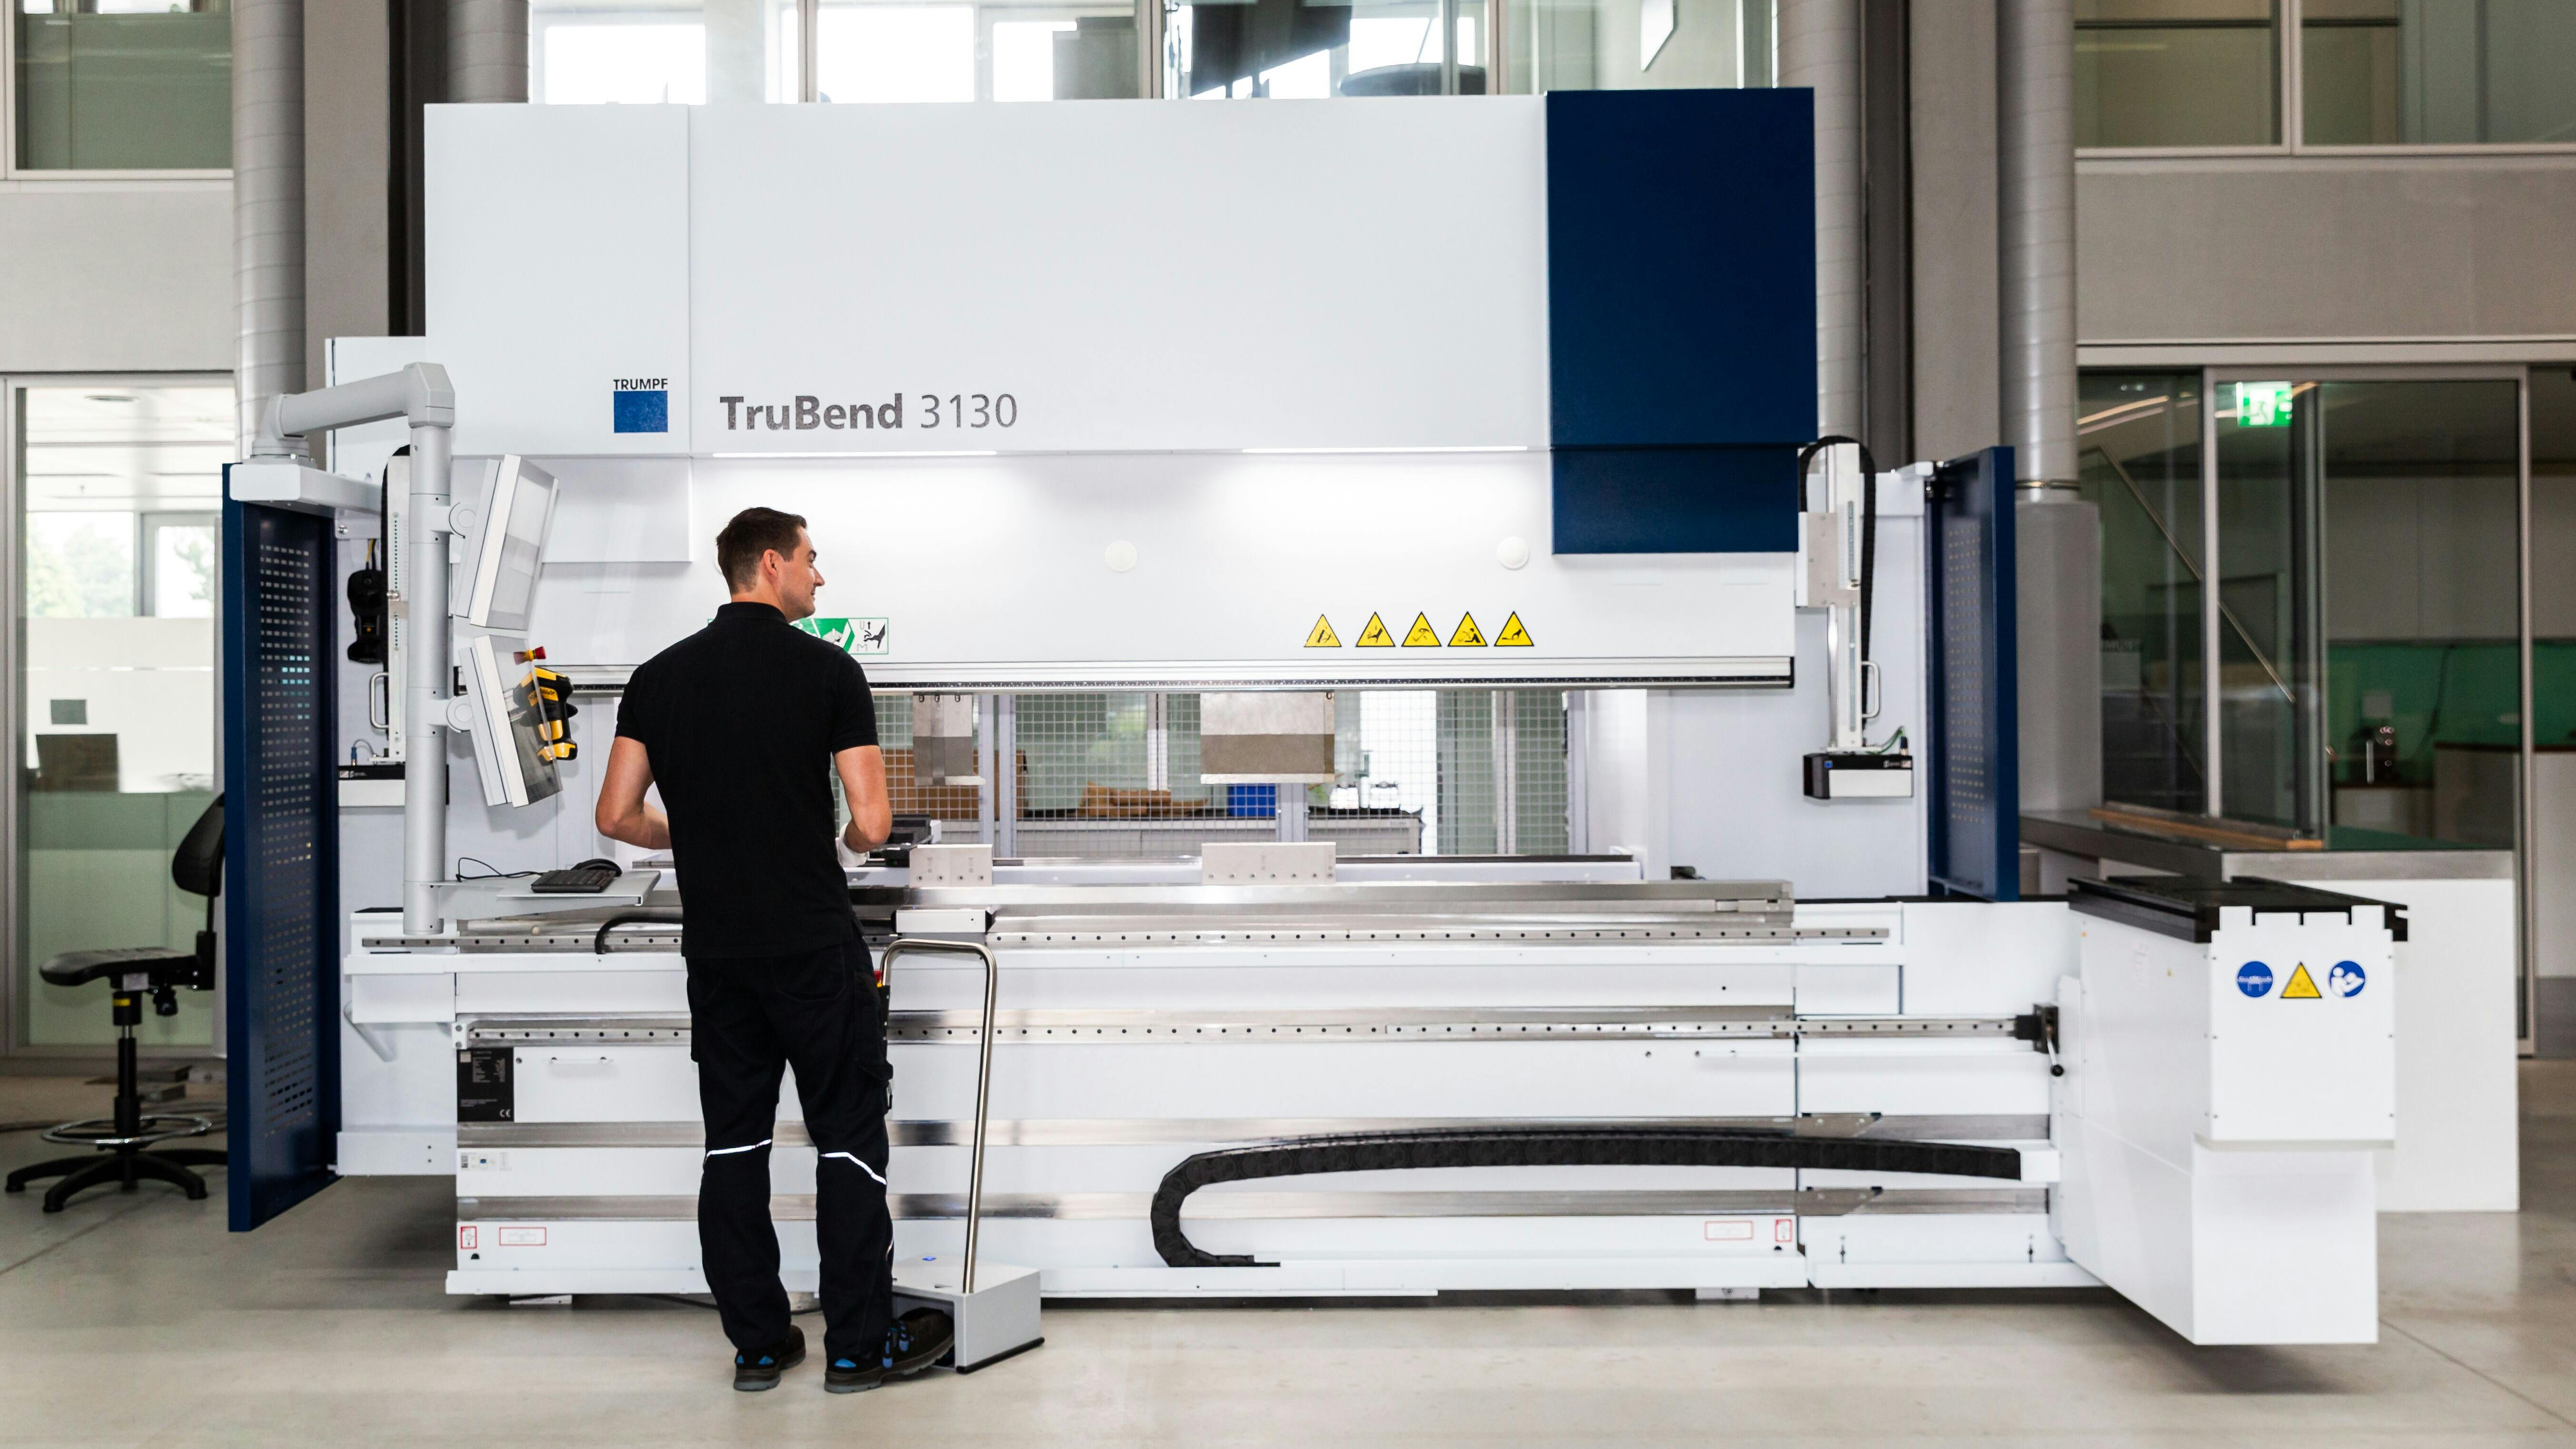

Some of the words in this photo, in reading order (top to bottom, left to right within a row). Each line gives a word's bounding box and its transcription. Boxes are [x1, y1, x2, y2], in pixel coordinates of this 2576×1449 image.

[613, 378, 668, 390] TRUMPF
[720, 393, 903, 430] TruBend
[921, 394, 1017, 428] 3130
